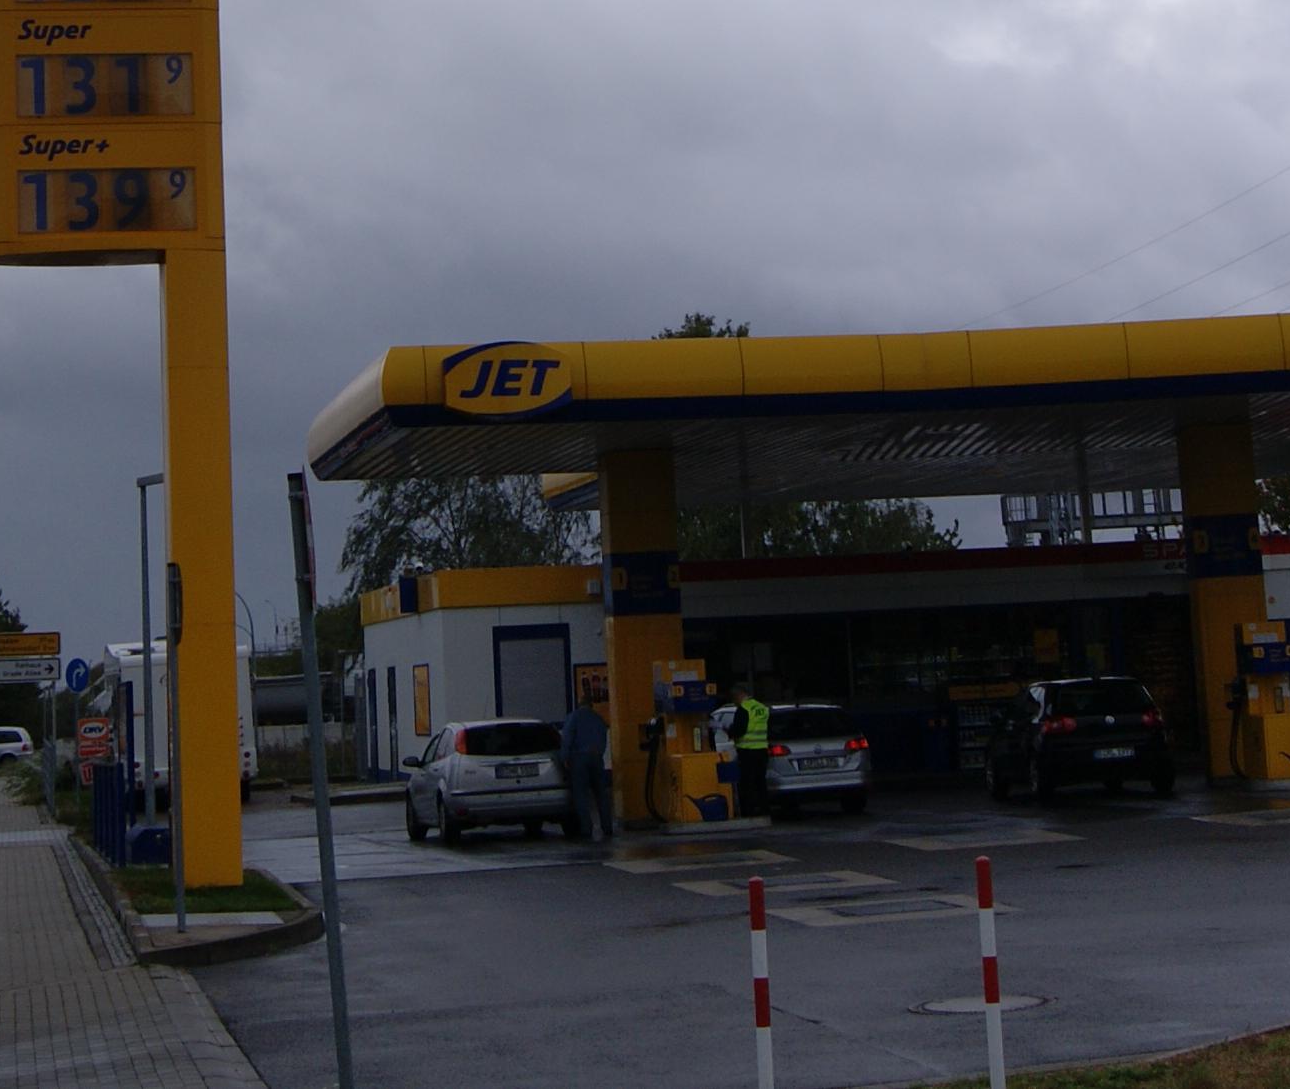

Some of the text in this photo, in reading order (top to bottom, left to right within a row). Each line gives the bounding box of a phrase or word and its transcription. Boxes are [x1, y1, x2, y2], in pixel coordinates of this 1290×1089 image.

[17, 20, 91, 44] Super
[18, 135, 110, 159] Super+
[460, 360, 559, 398] JET
